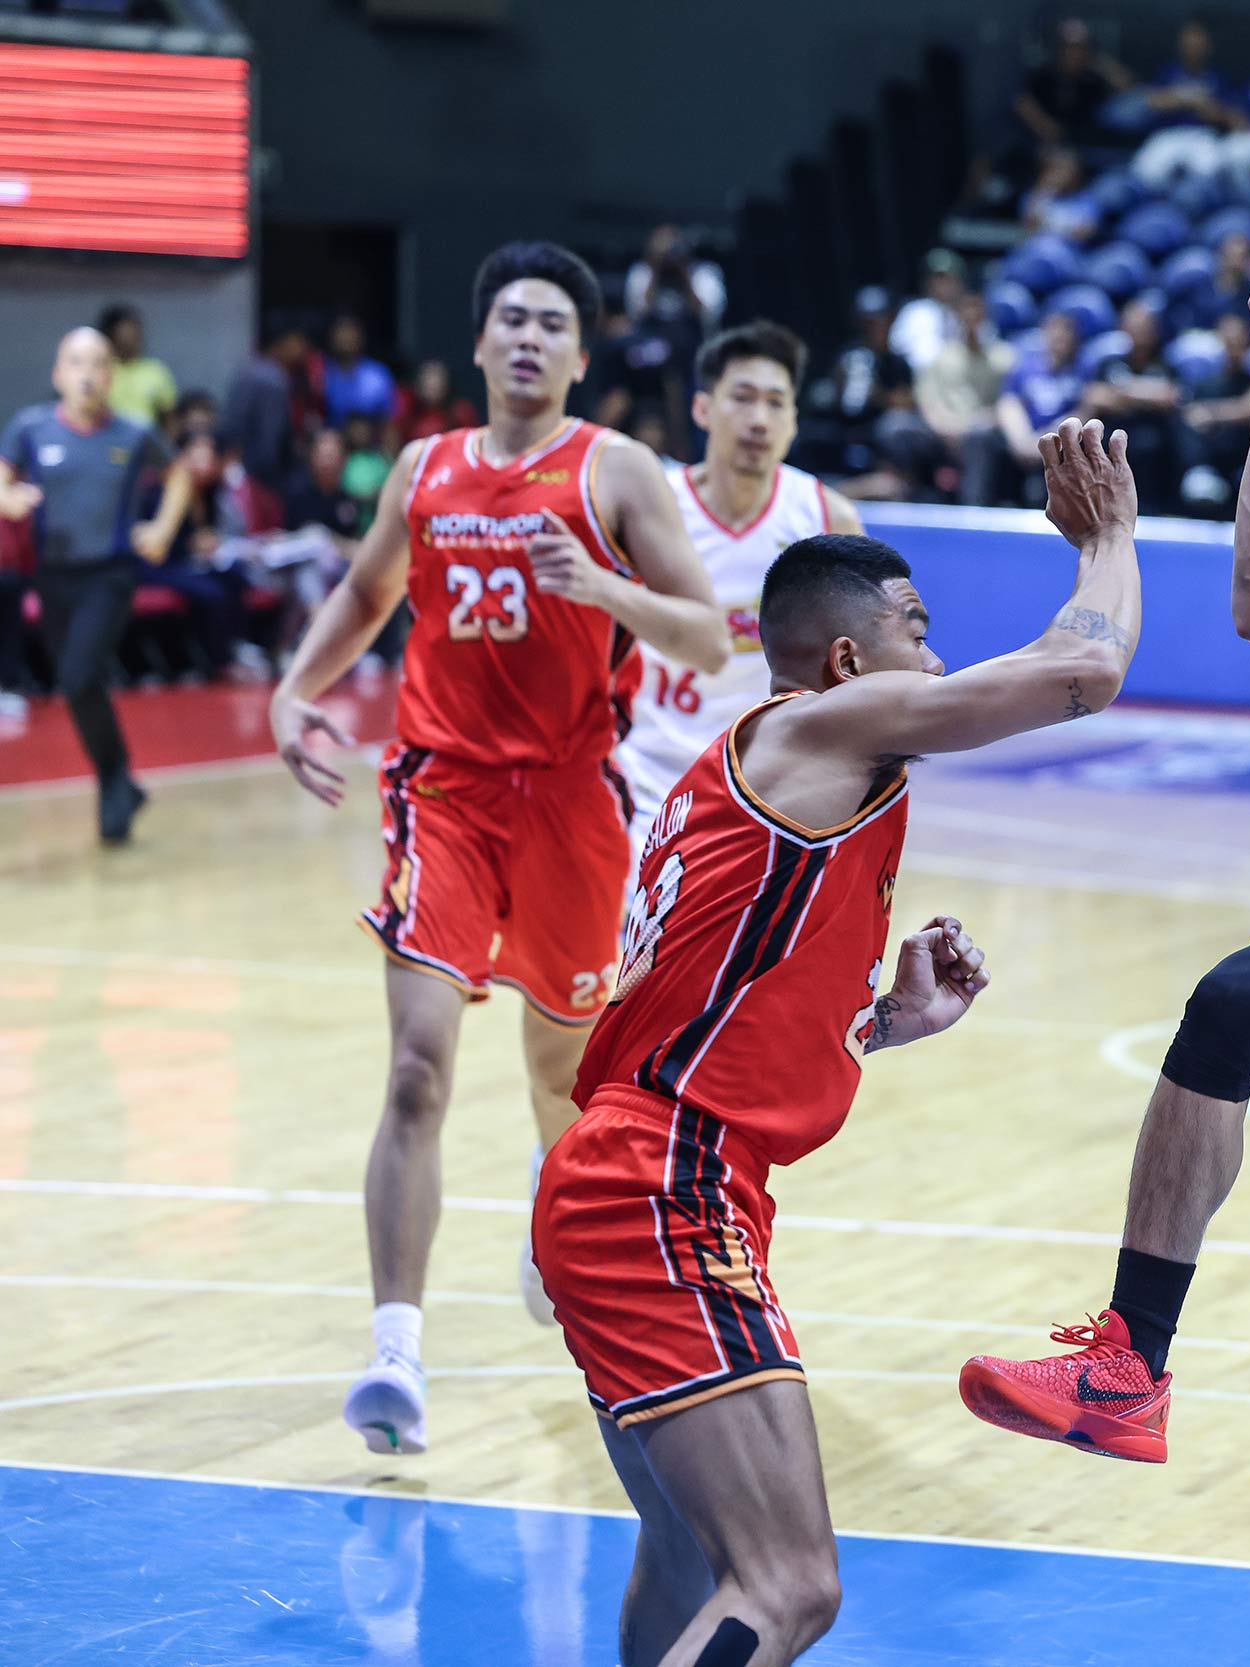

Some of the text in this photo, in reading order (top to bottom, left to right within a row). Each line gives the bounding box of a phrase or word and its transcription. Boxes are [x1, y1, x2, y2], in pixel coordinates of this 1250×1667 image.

[431, 513, 547, 537] NORTHPOR
[446, 564, 528, 641] 23
[655, 663, 702, 714] 16
